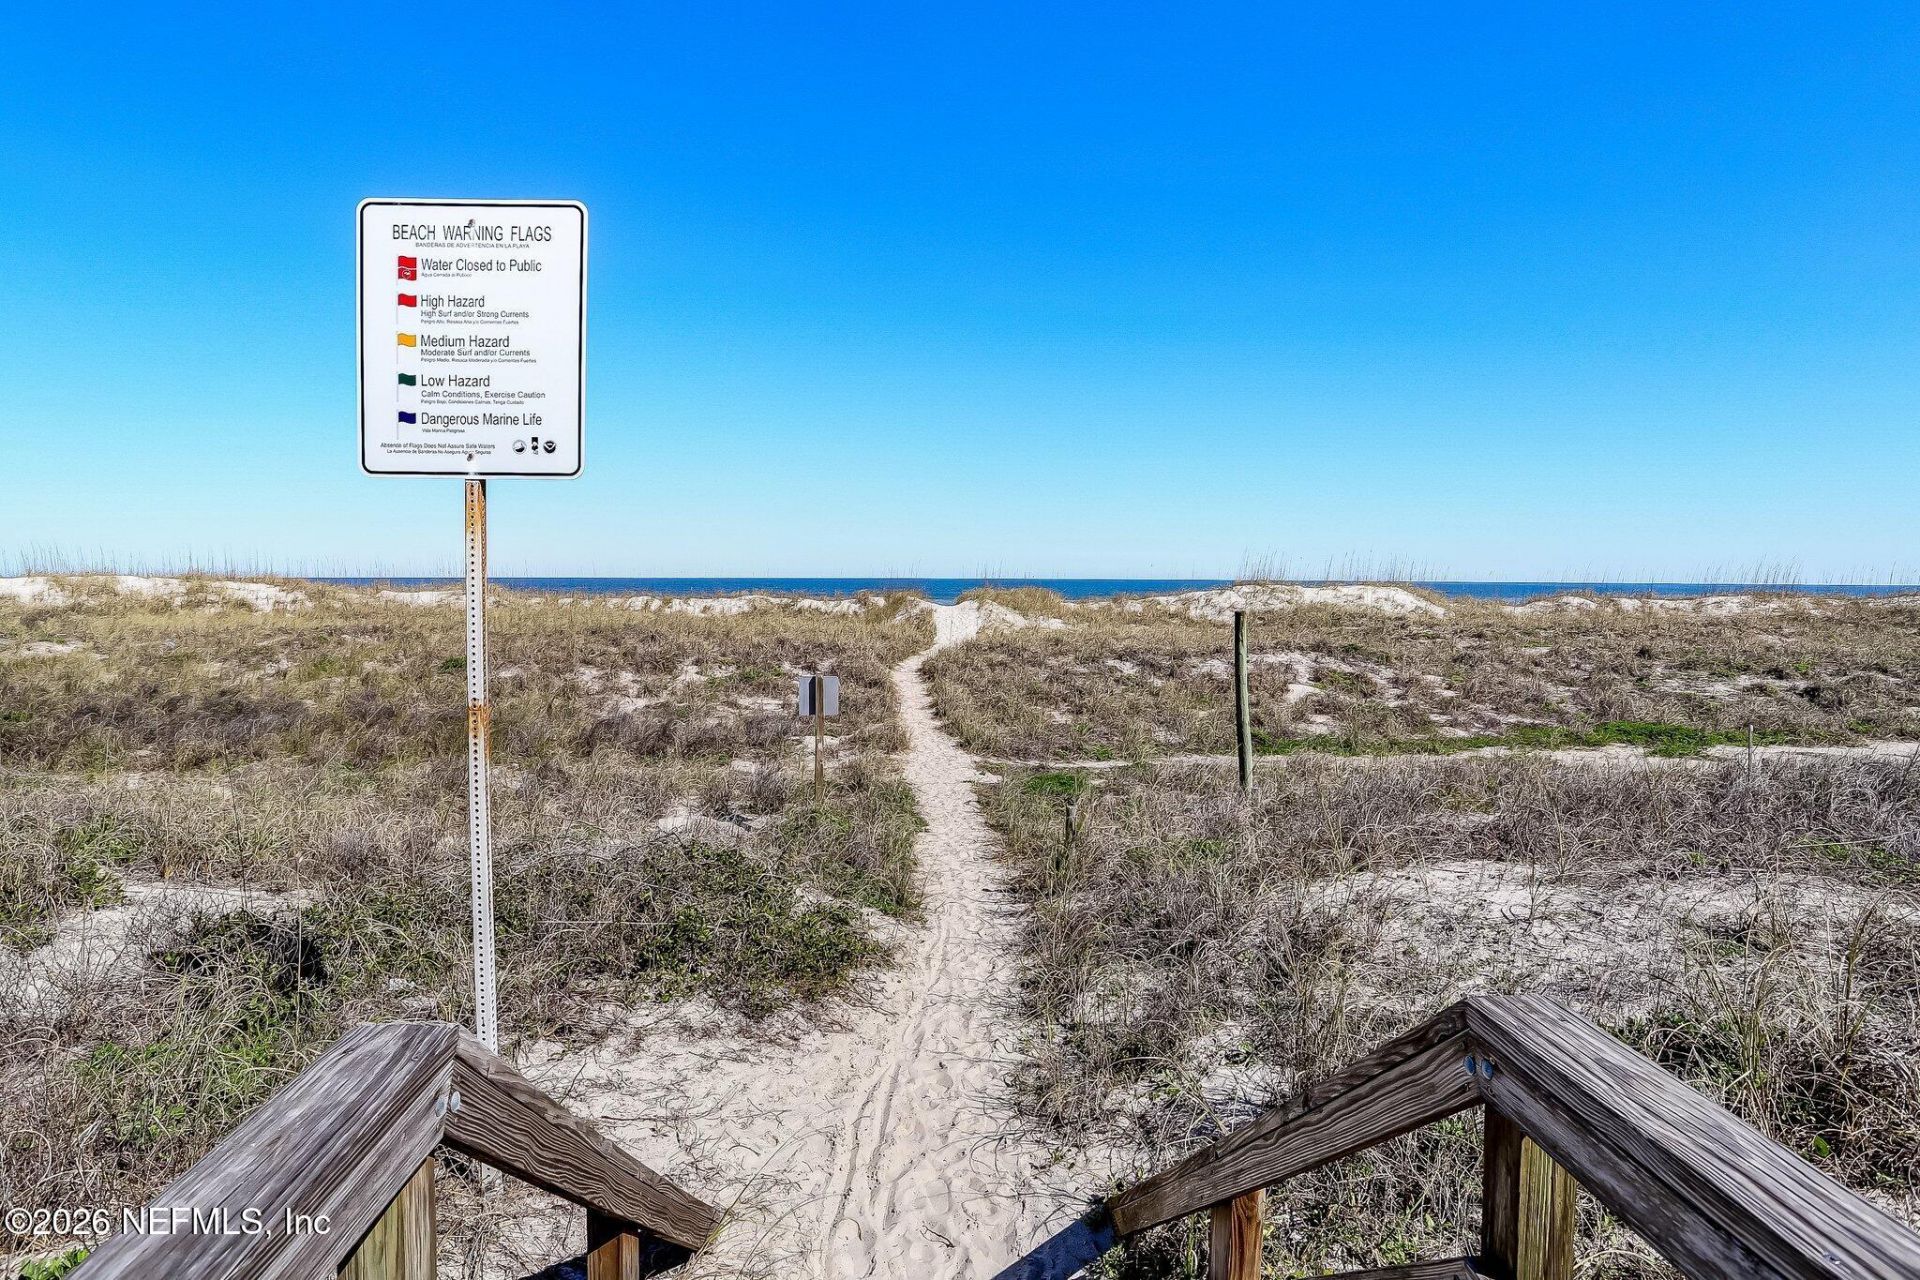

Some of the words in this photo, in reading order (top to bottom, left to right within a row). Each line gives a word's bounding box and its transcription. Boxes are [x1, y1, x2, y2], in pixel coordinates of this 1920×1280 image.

[392, 224, 435, 240] BEACH
[443, 225, 503, 241] WARNING
[511, 226, 551, 242] FLAGS
[421, 258, 453, 271] Water
[456, 258, 492, 272] Closed
[497, 260, 506, 272] to
[510, 259, 542, 272] Public
[420, 295, 444, 310] High
[447, 295, 485, 308] Hazard
[420, 310, 436, 319] High
[438, 310, 453, 318] Surf
[454, 310, 475, 318] and/or
[476, 311, 499, 319] Strong
[420, 335, 465, 347] Medium
[469, 335, 510, 348] Hazard
[499, 349, 531, 357] Currents
[421, 374, 445, 386] Low
[448, 375, 490, 387] Hazard
[421, 390, 440, 398] Calm
[442, 390, 483, 399] Conditions,
[421, 412, 479, 428] Dangerous
[482, 413, 519, 425] Marine
[523, 413, 542, 425] Life
